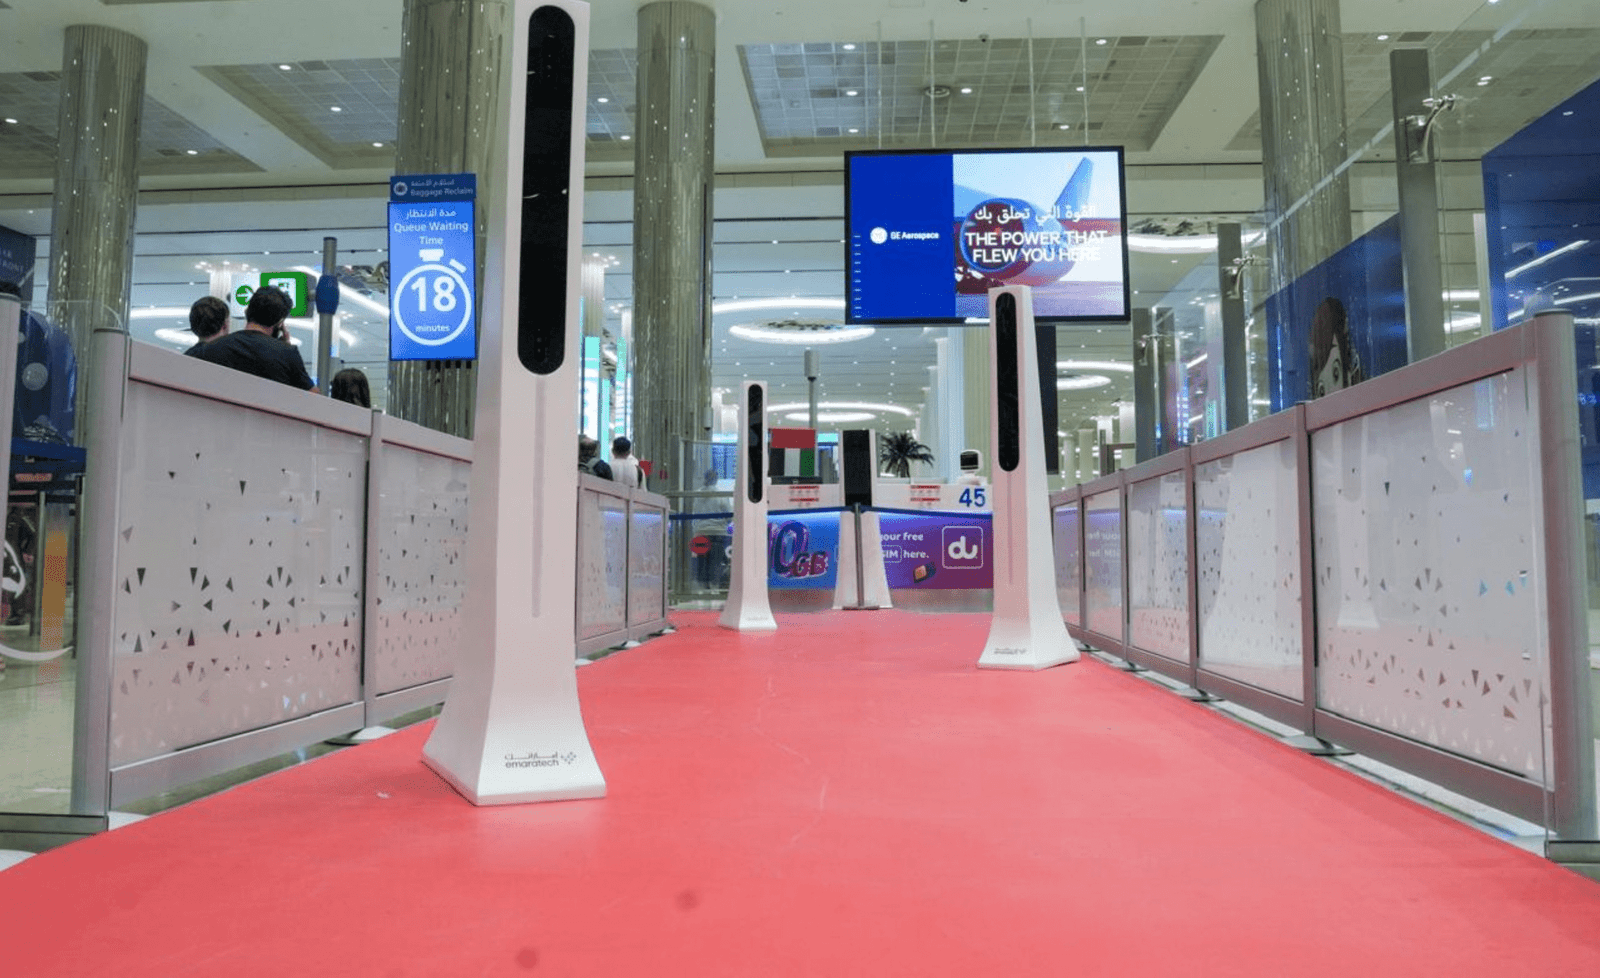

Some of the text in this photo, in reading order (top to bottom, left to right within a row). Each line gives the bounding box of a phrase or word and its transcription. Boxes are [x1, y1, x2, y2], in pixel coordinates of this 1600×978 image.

[410, 186, 474, 197] Baggage Reclaim
[439, 209, 457, 217] مدة
[974, 203, 1097, 226] القوة التي تحلق بك
[394, 220, 469, 233] Queue Waiting
[419, 236, 445, 245] Time
[890, 231, 940, 241] GE Aerospace
[965, 230, 1108, 246] THE POWER THAT
[972, 247, 1102, 263] FLEW YOU HERE
[411, 276, 457, 312] 18
[415, 324, 450, 332] minutes
[959, 487, 986, 507] 45
[903, 531, 924, 541] free
[947, 535, 979, 560] du
[903, 549, 930, 559] here.
[791, 551, 830, 578] GB
[505, 759, 560, 769] emaratech
